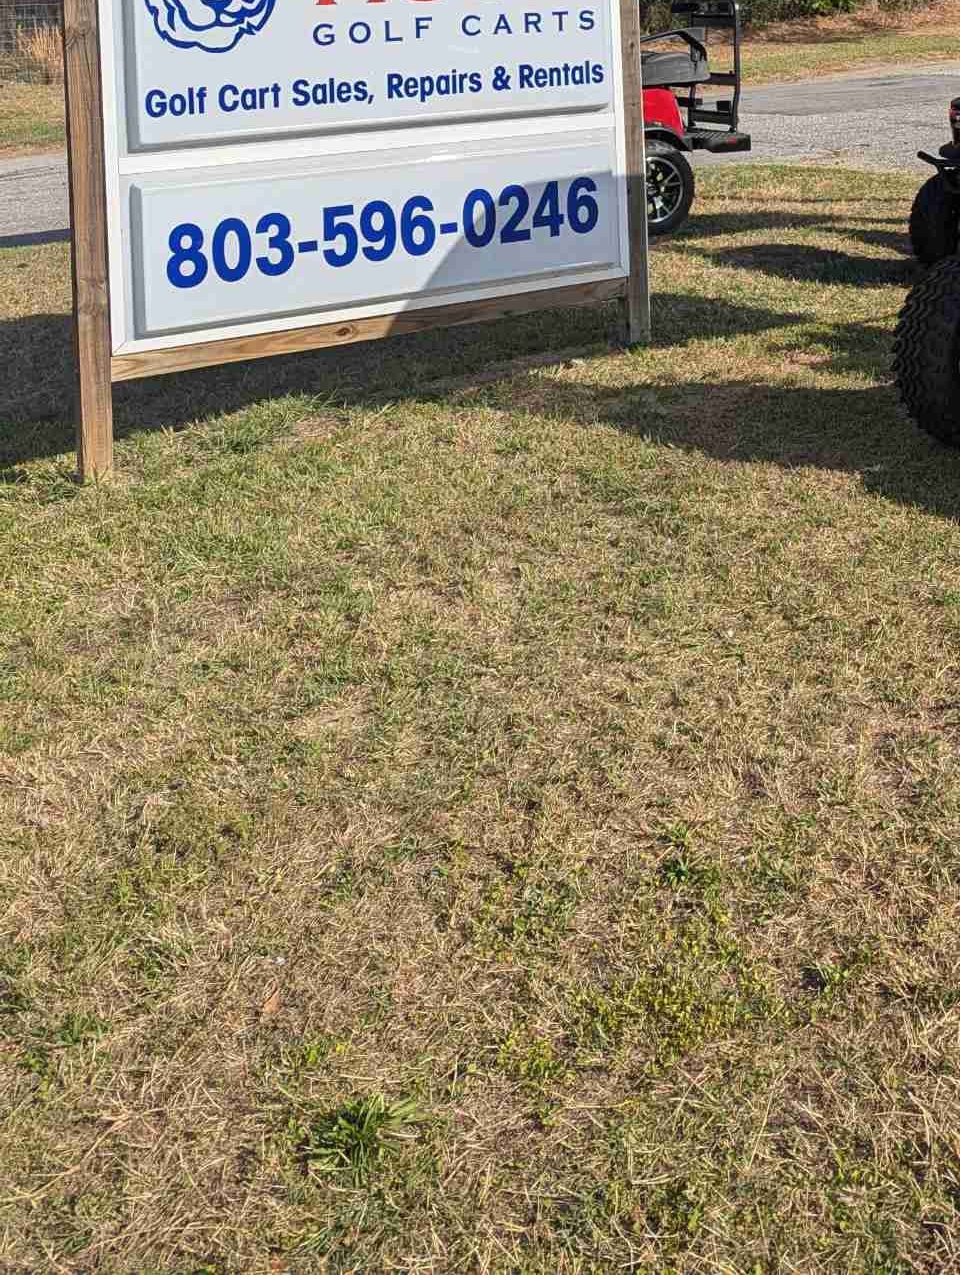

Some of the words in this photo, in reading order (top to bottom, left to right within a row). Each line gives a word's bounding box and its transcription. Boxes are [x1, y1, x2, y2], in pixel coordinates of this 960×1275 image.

[312, 16, 432, 46] GOLF
[461, 10, 595, 36] CARTS
[144, 86, 207, 118] Golf
[218, 82, 281, 112] Cart
[292, 77, 374, 106] Sales,
[387, 69, 482, 101] Repairs
[492, 66, 511, 91] &
[518, 60, 604, 89] Rentals
[166, 177, 599, 289] 803-596-0246
